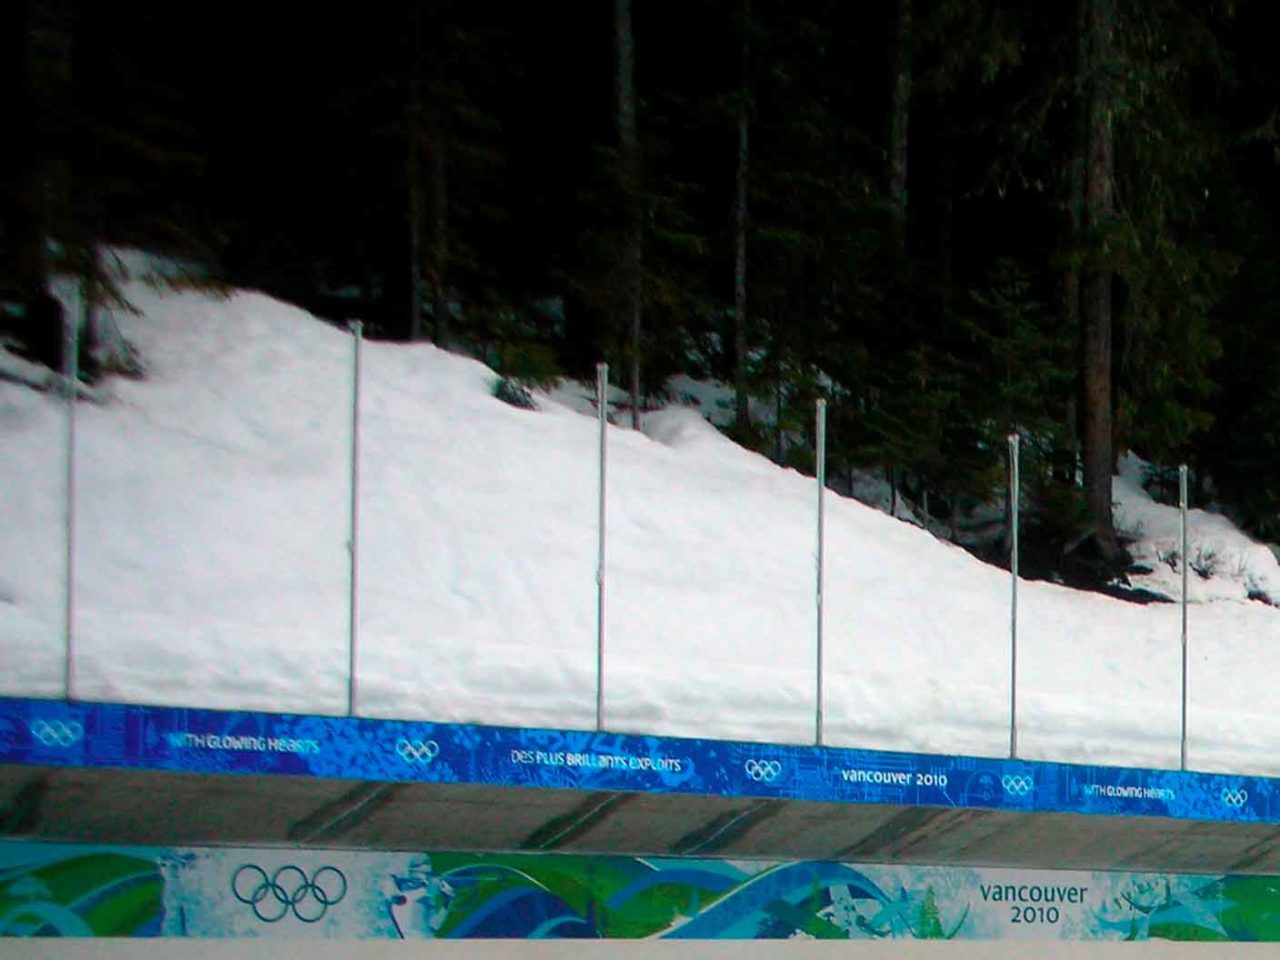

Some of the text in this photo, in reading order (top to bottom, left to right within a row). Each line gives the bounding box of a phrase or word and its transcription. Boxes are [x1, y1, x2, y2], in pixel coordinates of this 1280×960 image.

[536, 751, 565, 766] PLUS
[842, 769, 948, 787] vancouver 2010
[980, 884, 1088, 903] vancouver
[1010, 906, 1060, 924] 2010
